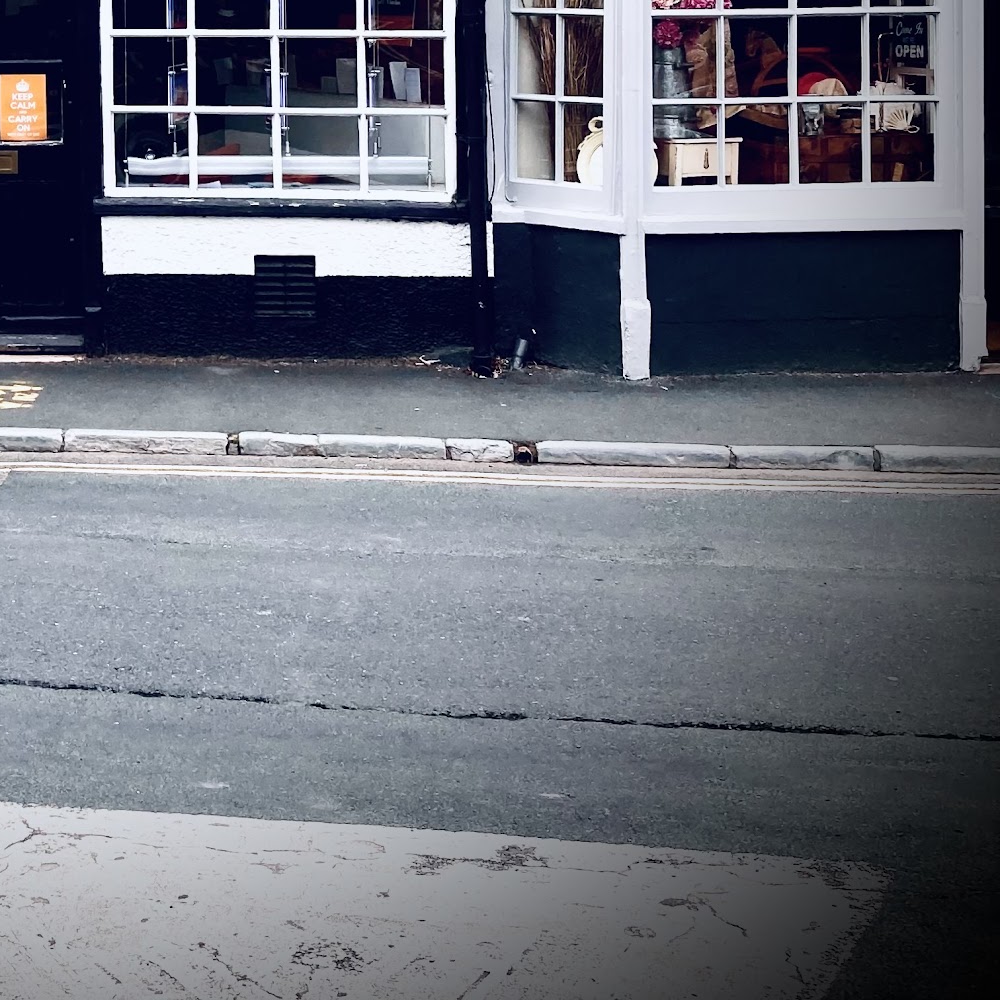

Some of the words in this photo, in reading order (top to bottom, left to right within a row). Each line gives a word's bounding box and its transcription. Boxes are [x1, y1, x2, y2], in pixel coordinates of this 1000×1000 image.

[895, 44, 924, 58] OPEN
[10, 101, 36, 109] CALM
[7, 115, 38, 123] CARRY
